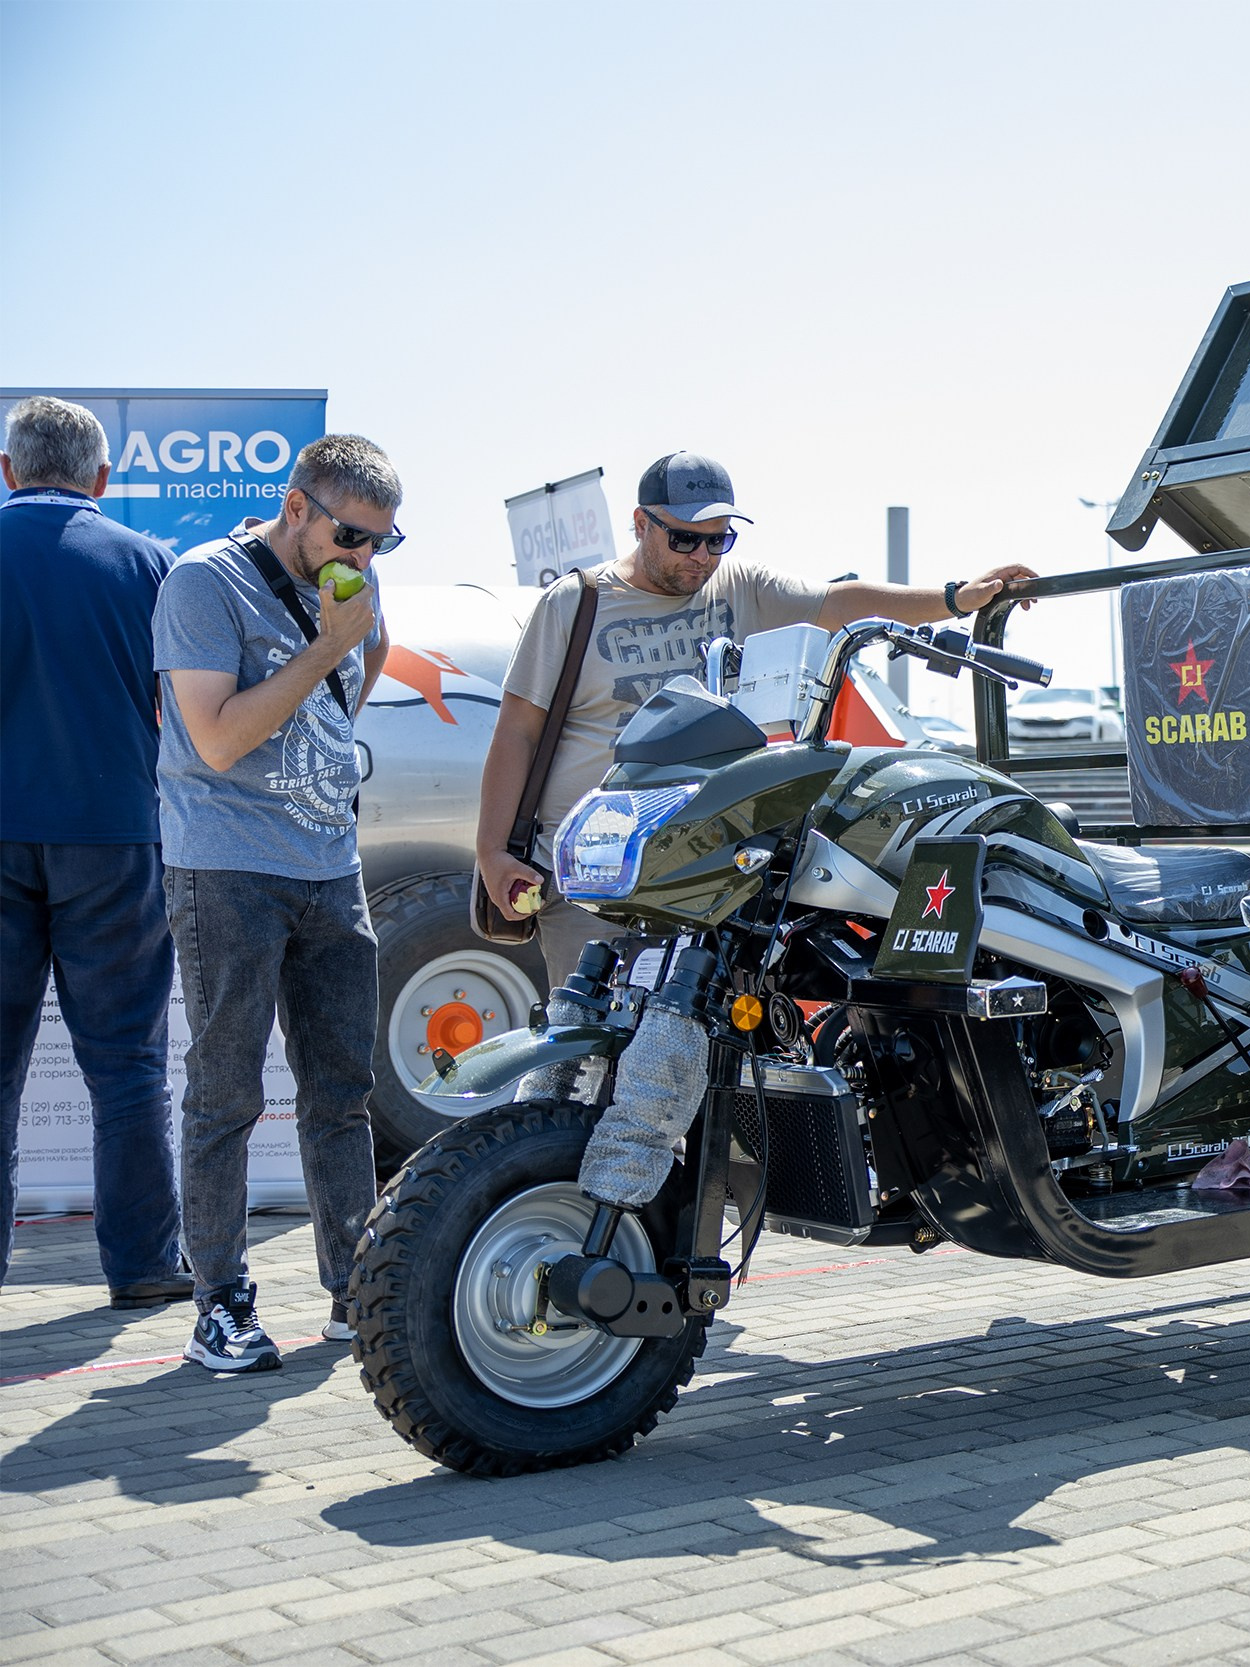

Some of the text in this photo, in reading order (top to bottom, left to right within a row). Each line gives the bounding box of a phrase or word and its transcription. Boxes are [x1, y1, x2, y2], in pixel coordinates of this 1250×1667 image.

[117, 430, 291, 474] AGRO
[167, 479, 287, 499] machines
[1145, 711, 1247, 745] SCARAB
[269, 765, 343, 789] STRIKE FAST
[902, 785, 978, 815] CJ Scarab
[283, 801, 322, 832] DEFINED
[1201, 885, 1213, 896] CJ
[892, 929, 960, 954] CJ SCARAB
[1134, 935, 1156, 955] CJ
[1168, 1144, 1182, 1158] CJ
[1186, 1138, 1229, 1155] Scarab
